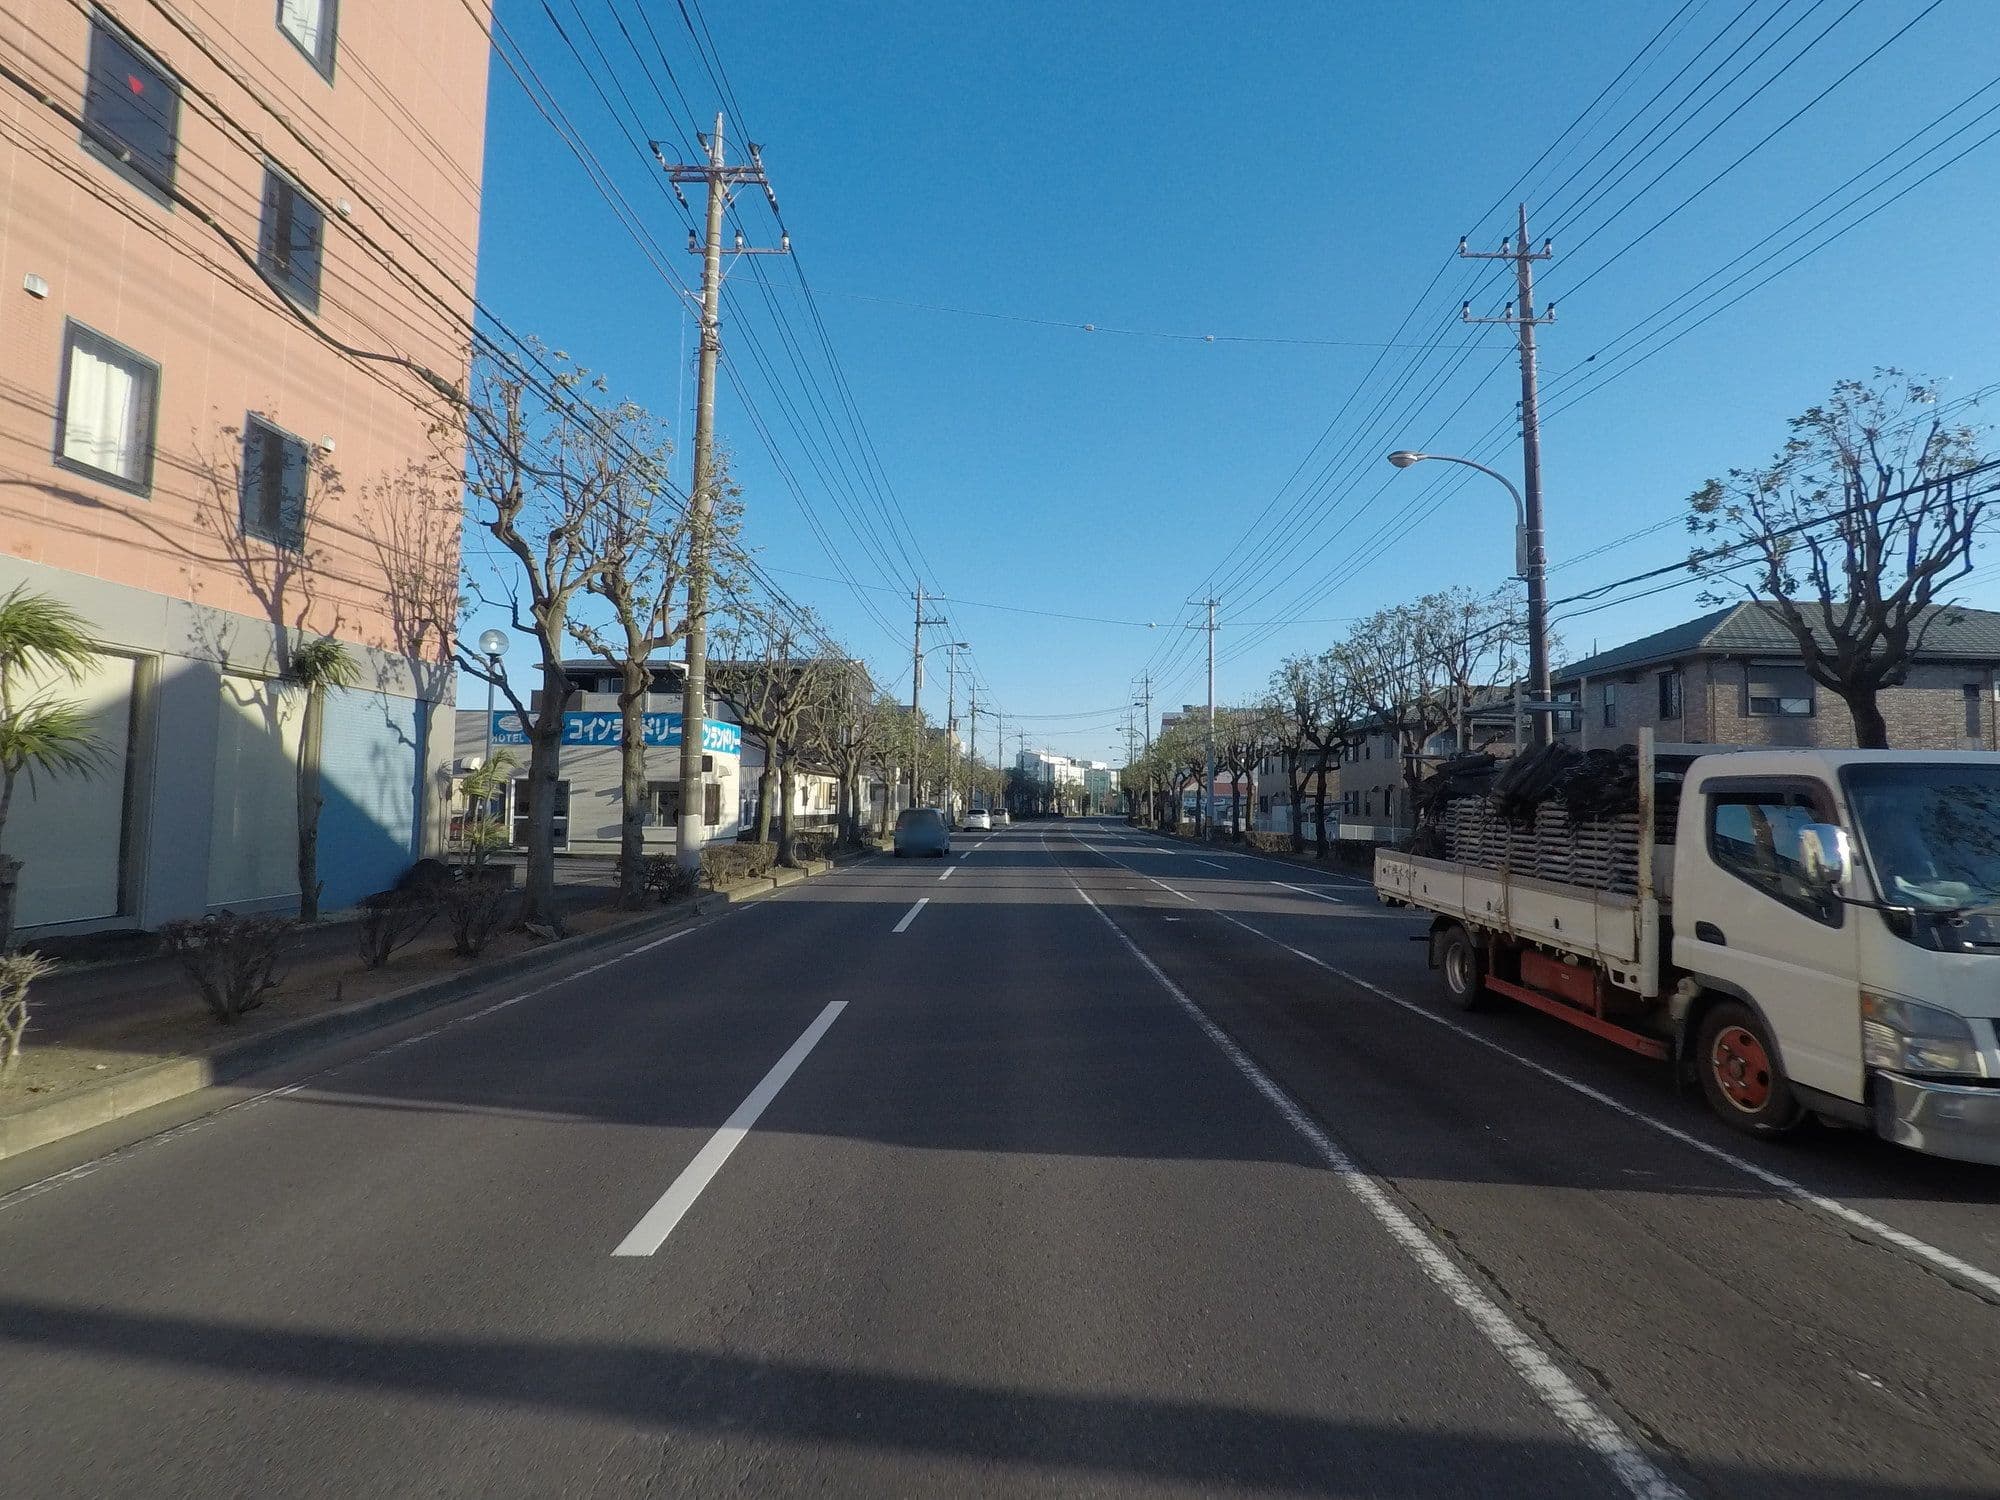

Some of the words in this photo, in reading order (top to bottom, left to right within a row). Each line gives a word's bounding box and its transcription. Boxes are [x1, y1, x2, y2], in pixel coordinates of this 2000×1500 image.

[569, 718, 682, 742] コインラドリー
